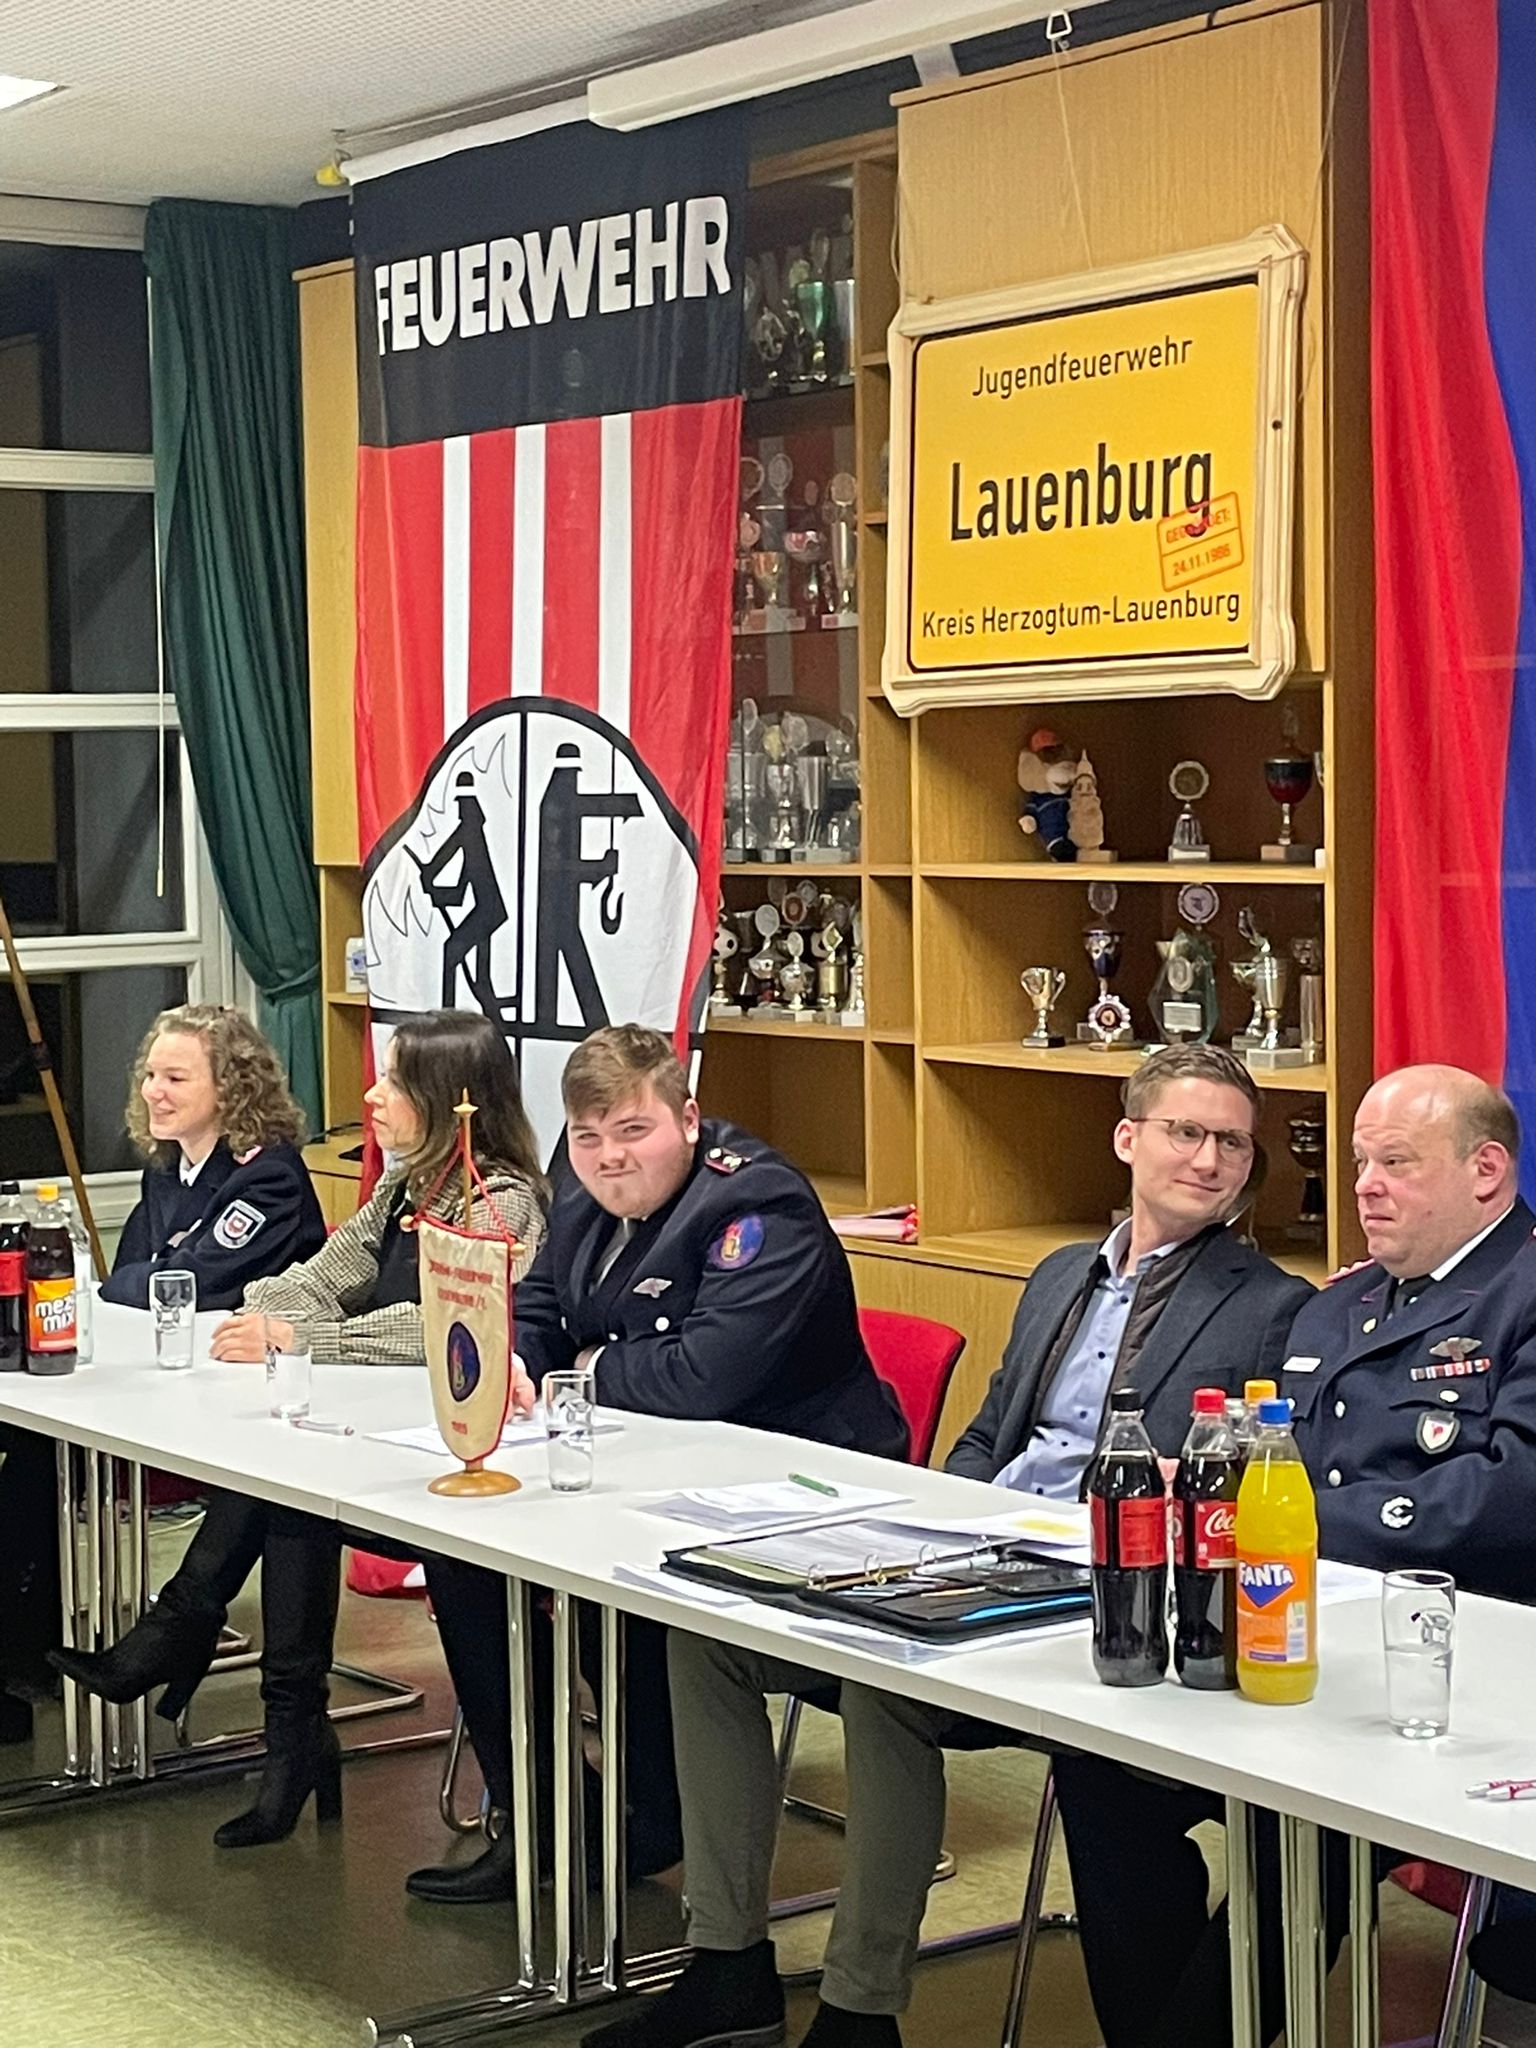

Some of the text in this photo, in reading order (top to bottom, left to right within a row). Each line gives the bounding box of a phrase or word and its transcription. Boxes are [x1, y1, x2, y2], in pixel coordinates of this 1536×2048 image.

[374, 196, 731, 356] FEUERWEHR
[972, 335, 1193, 399] Jugendfeuerwehr
[951, 442, 1213, 540] Lauenburg
[922, 590, 1240, 638] Kreis Herzogtum-Lauenburg
